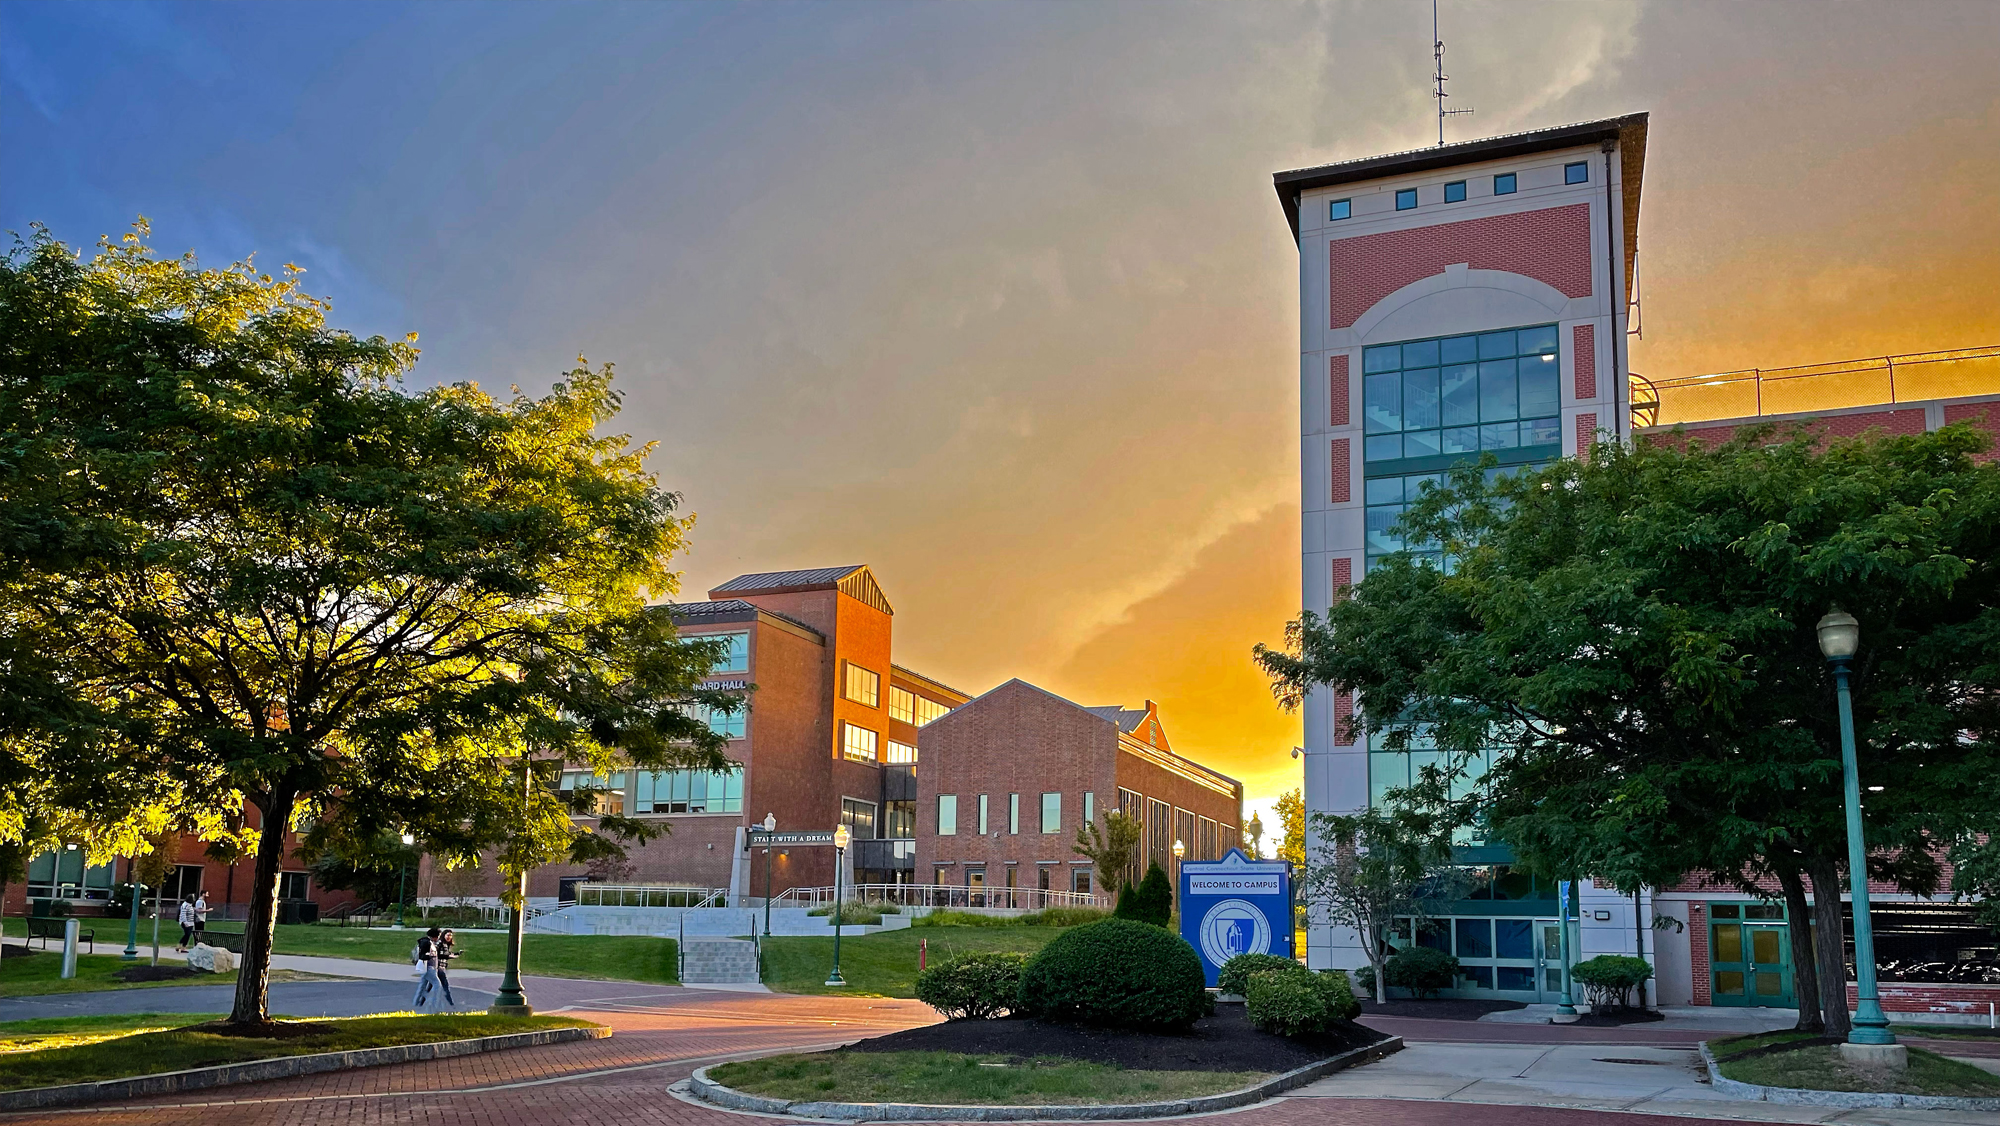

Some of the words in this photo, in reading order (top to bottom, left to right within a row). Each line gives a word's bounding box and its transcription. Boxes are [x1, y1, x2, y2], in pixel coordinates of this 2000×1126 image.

[721, 680, 746, 690] HALL
[1191, 881, 1230, 889] WELCOME
[1231, 881, 1242, 889] TO
[1244, 881, 1278, 889] CAMPUS
